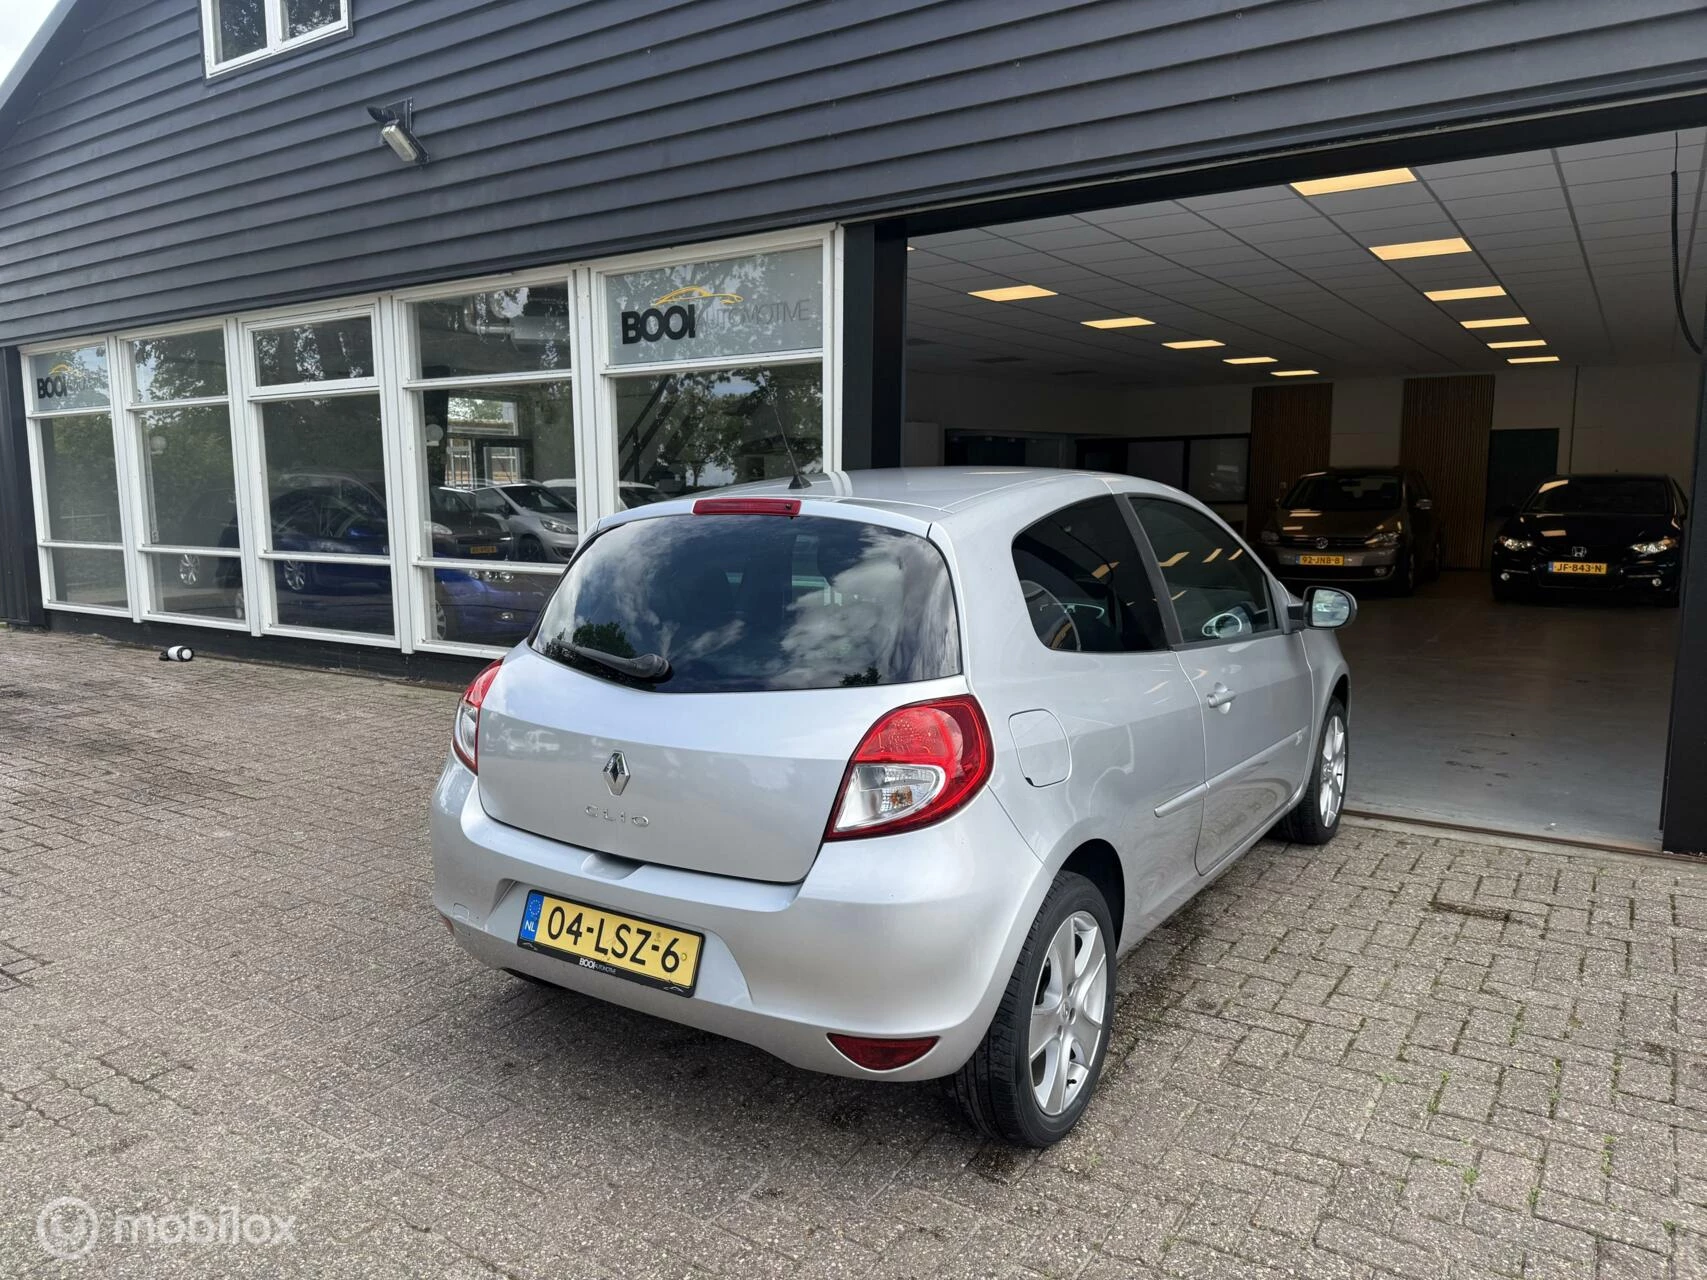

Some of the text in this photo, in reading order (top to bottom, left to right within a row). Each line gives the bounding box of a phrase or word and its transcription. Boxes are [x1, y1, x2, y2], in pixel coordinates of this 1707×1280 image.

[621, 304, 696, 344] BOOI
[37, 376, 68, 399] BOOI
[1557, 563, 1603, 573] JF-843-N
[585, 804, 649, 828] CLIO
[525, 920, 535, 932] NL
[548, 906, 680, 973] 04-LSZ-6
